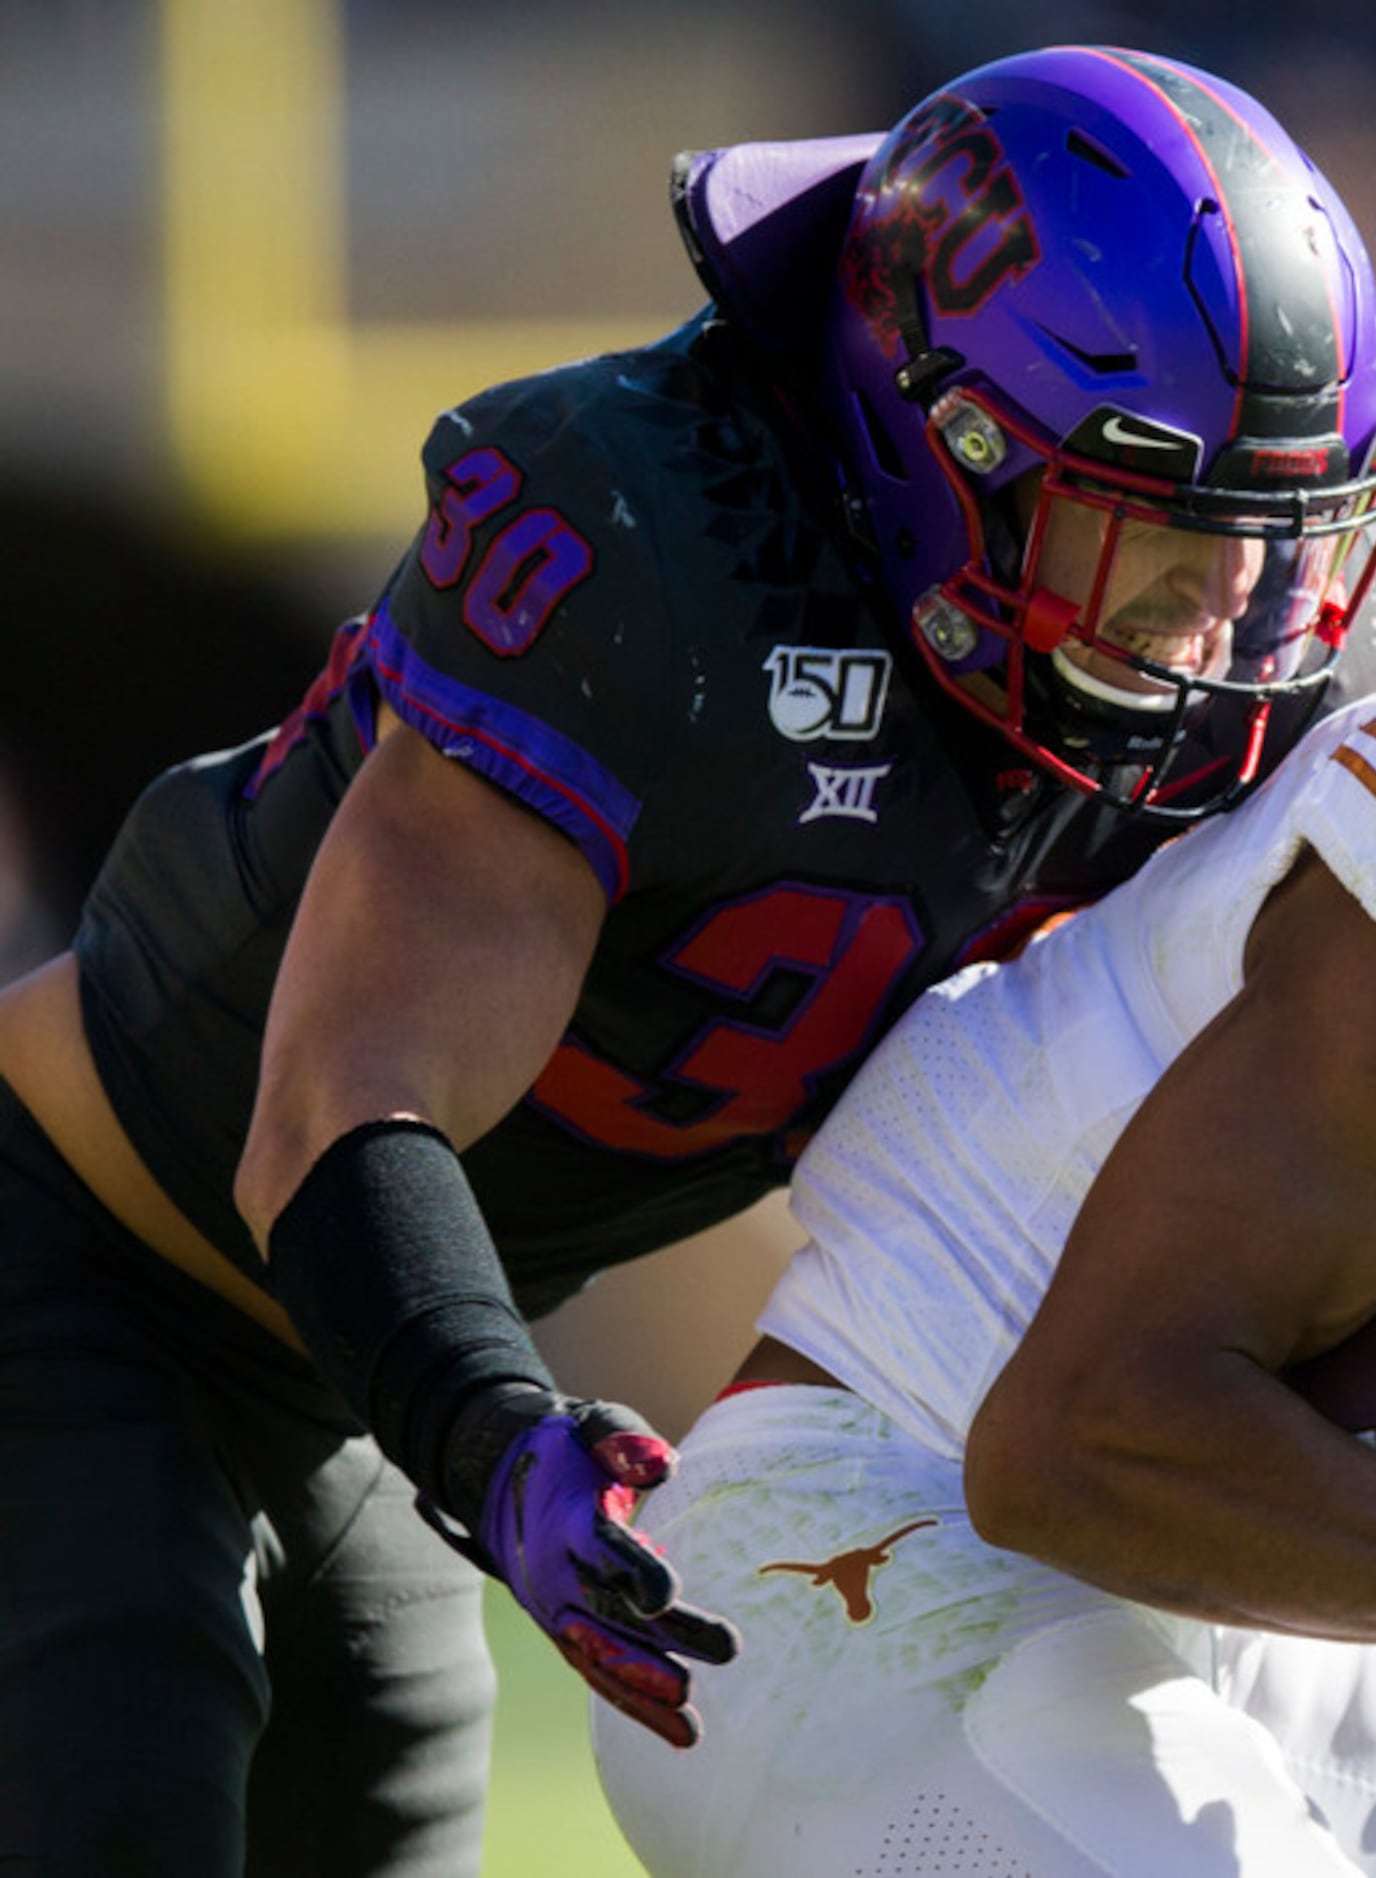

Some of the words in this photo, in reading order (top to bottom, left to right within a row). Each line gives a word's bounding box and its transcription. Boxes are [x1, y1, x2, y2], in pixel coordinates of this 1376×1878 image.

[417, 447, 594, 657] 30
[762, 645, 892, 742] 150
[799, 762, 892, 824] XII
[528, 880, 1078, 1163] 3
